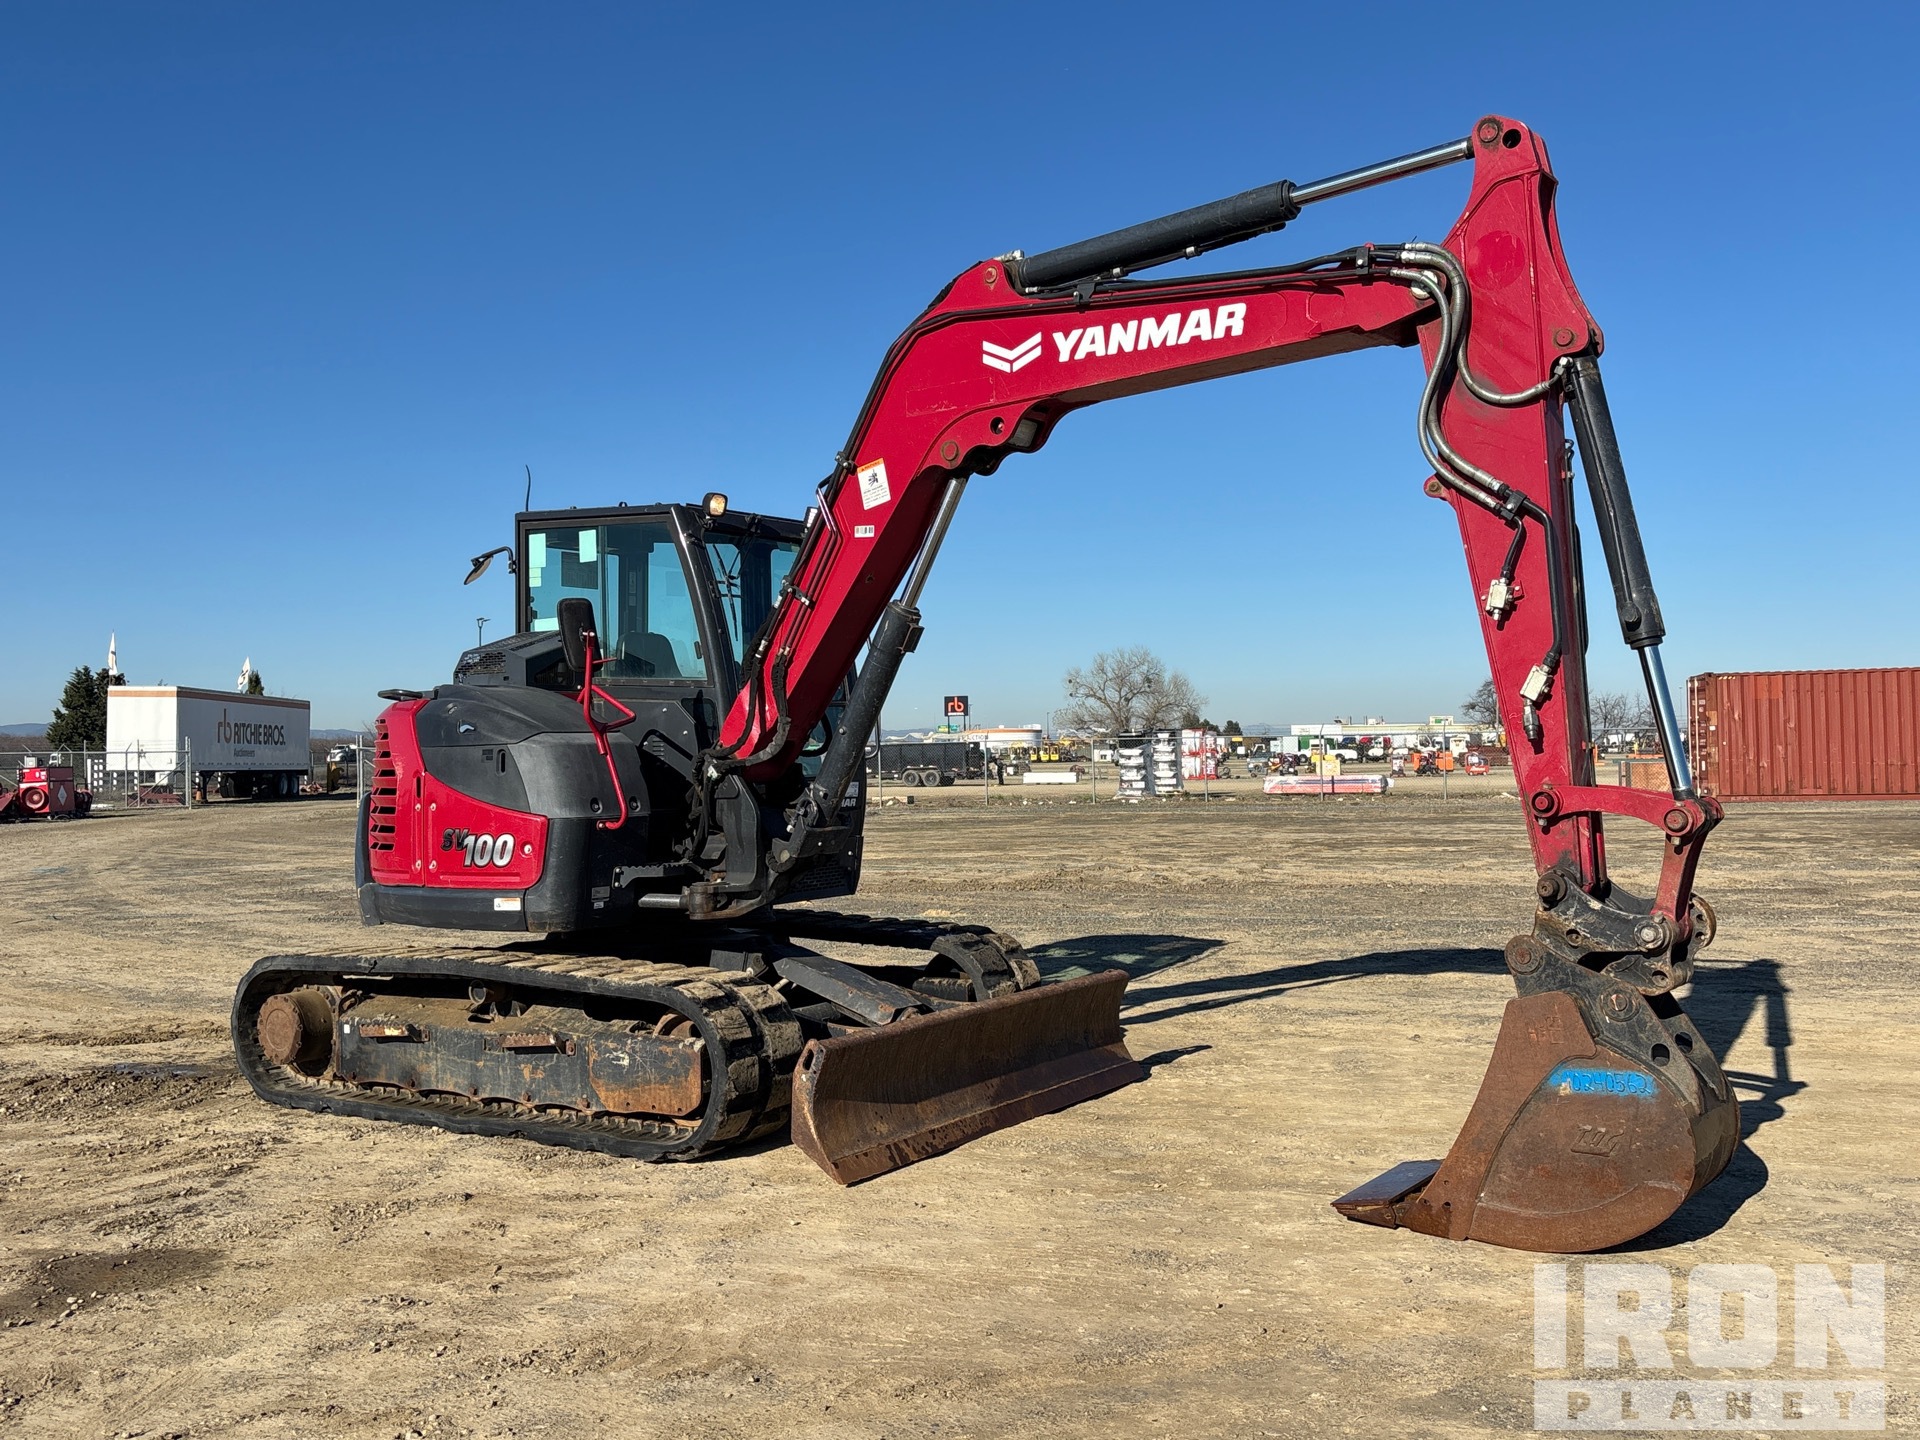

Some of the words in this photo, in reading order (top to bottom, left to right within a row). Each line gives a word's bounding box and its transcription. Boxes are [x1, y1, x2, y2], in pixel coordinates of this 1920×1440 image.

[1052, 303, 1247, 363] YANMAR
[233, 722, 262, 745] RITCHIE
[263, 724, 286, 746] BROS.
